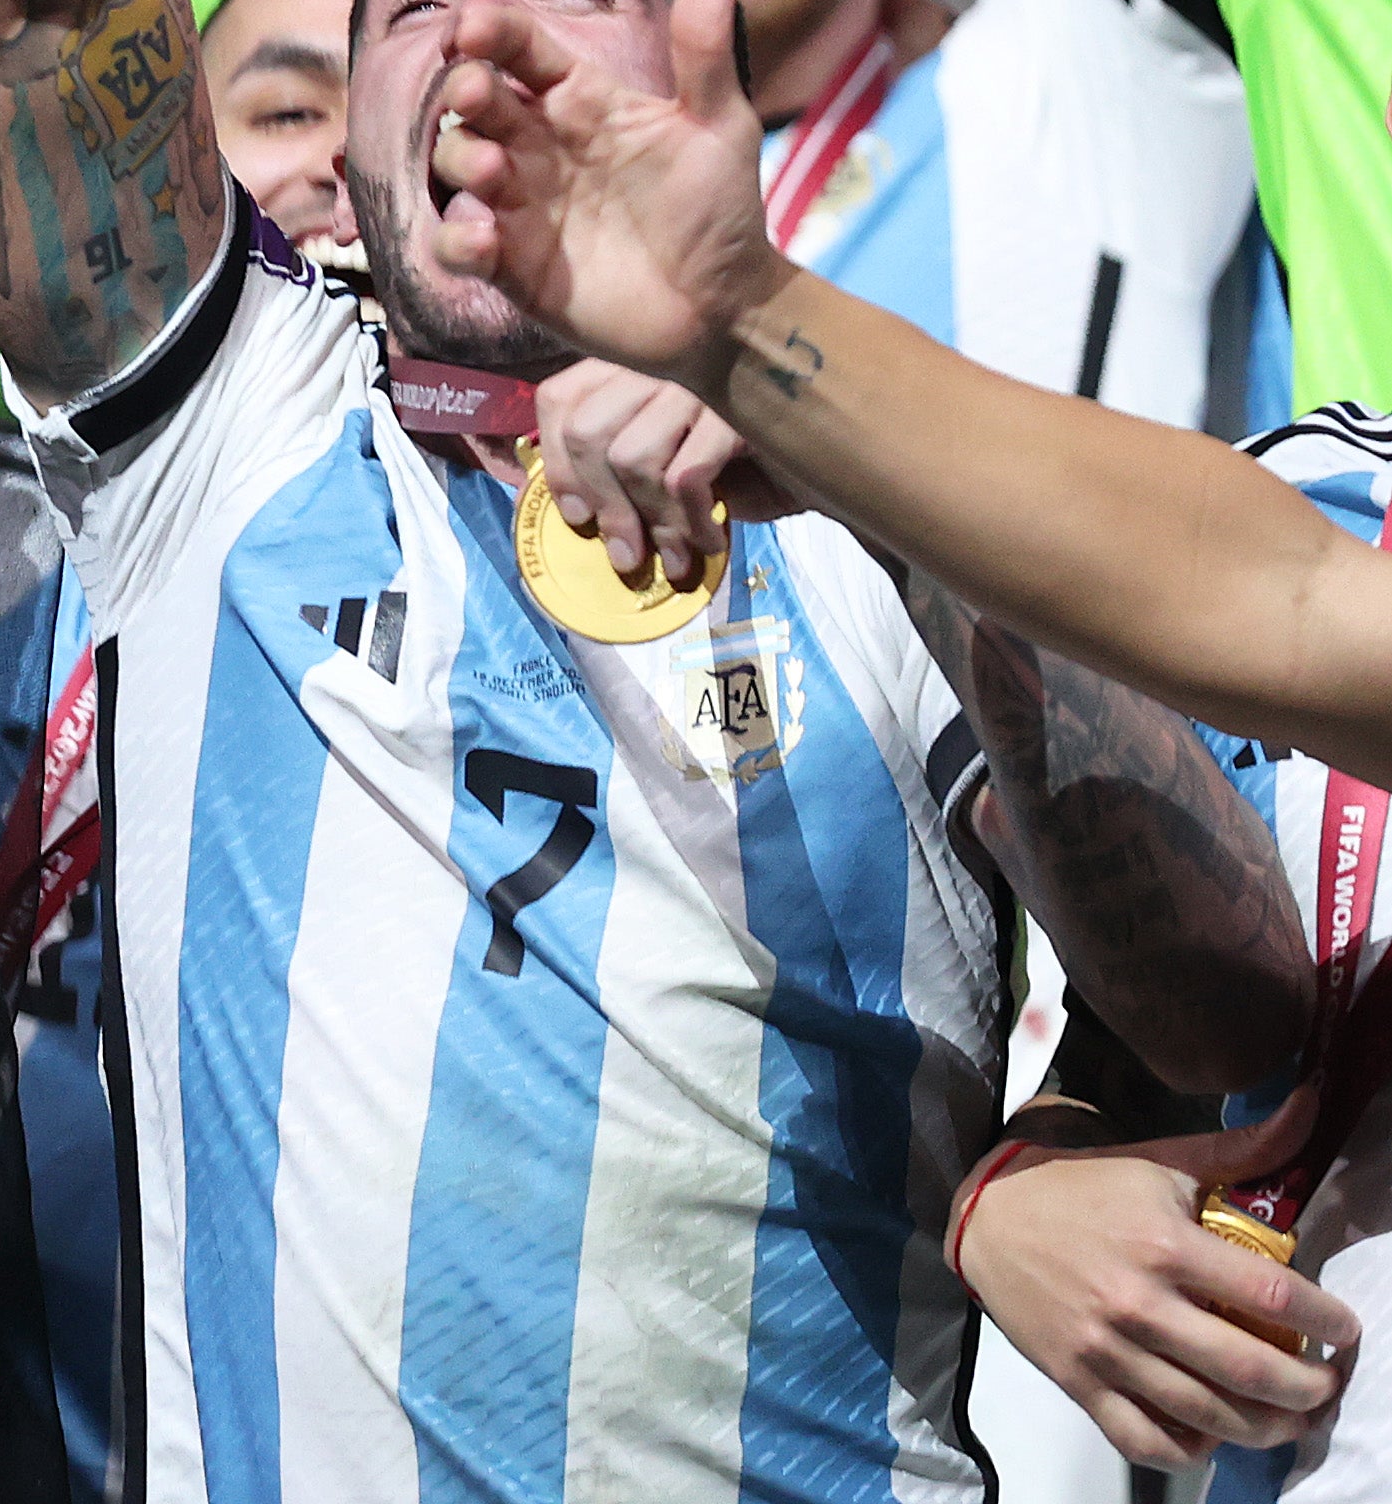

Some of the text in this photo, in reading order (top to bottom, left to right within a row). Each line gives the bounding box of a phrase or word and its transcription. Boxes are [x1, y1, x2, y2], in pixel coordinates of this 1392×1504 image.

[692, 663, 769, 735] AFA
[464, 748, 598, 979] 7
[1335, 804, 1366, 874] FIFA
